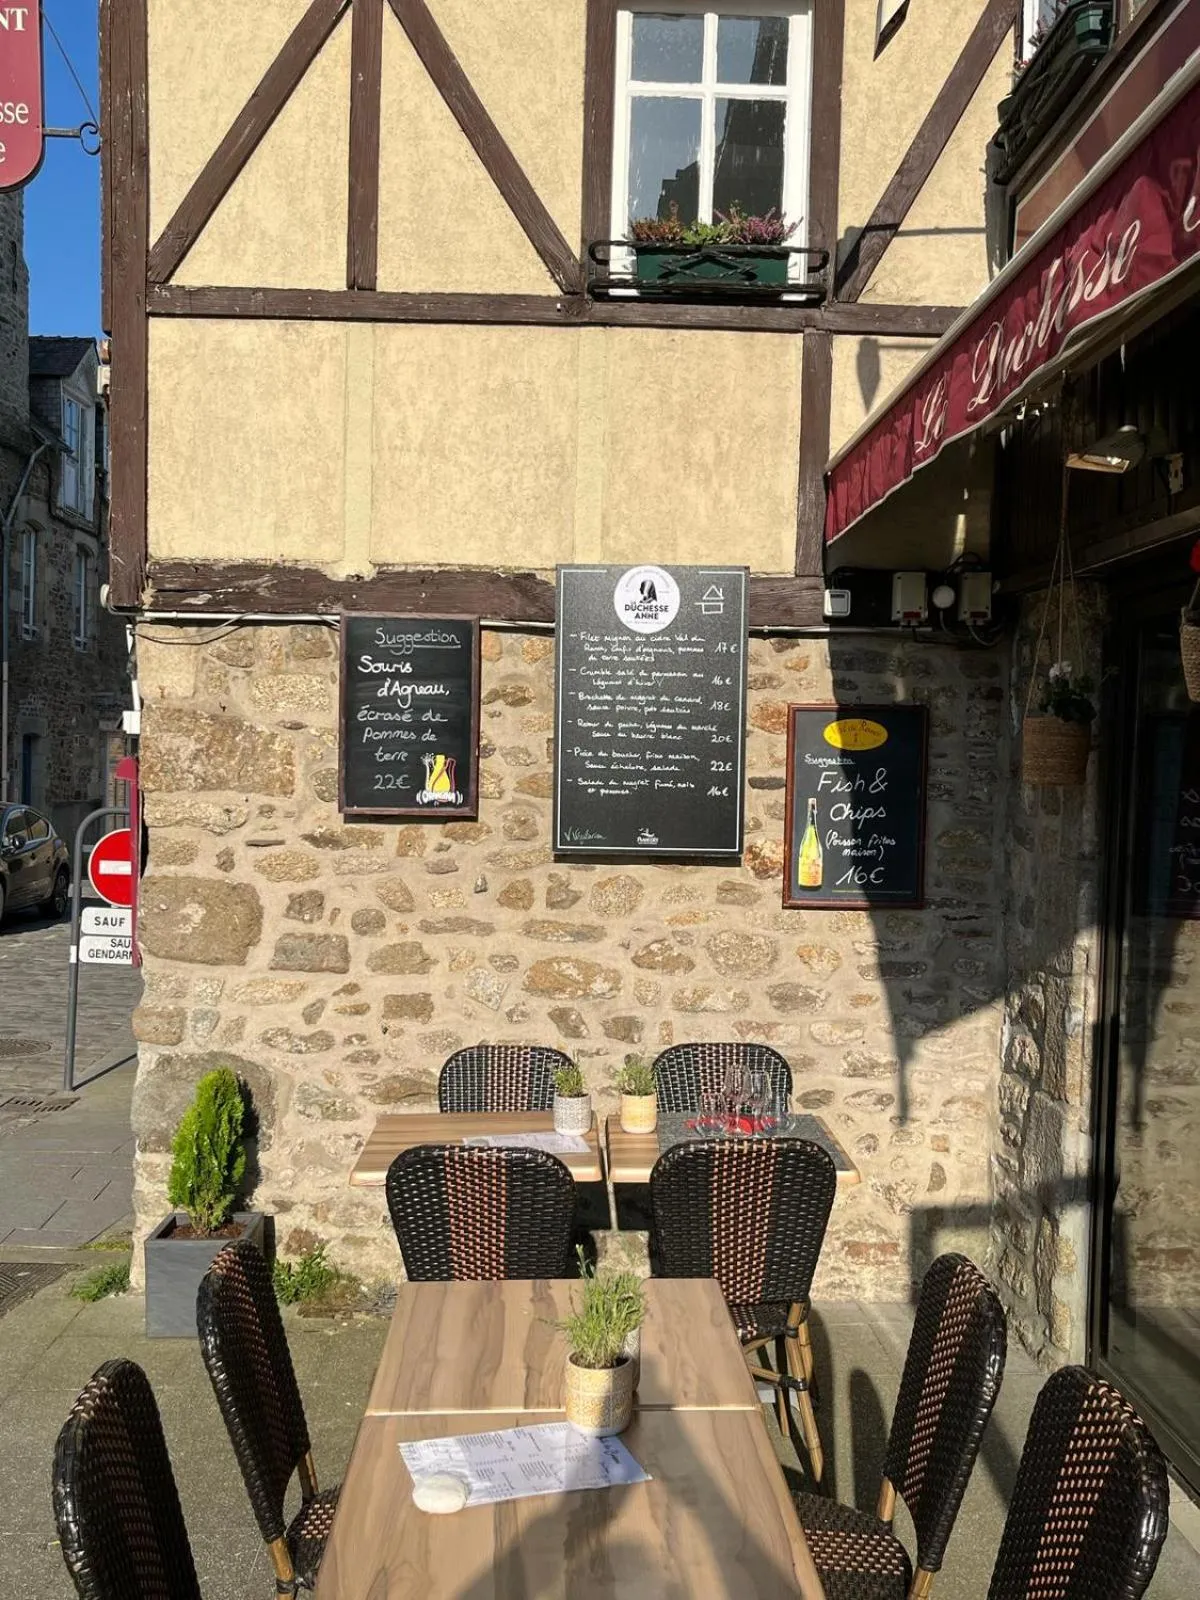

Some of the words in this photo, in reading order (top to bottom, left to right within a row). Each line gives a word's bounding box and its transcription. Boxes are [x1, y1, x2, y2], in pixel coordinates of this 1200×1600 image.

[967, 220, 1141, 412] Duchesse
[635, 612, 659, 620] ANNE
[374, 627, 461, 655] Suggestion
[357, 655, 413, 674] Souris
[377, 677, 450, 708] d'Agneau,
[710, 701, 731, 711] 18€
[421, 709, 448, 722] de
[420, 728, 438, 742] de
[712, 735, 733, 743] 20€
[374, 747, 409, 763] terre
[710, 761, 733, 772] 22€
[373, 774, 411, 790] 22€
[830, 802, 887, 830] Chips
[836, 865, 885, 885] 16€
[94, 916, 126, 927] SAUF
